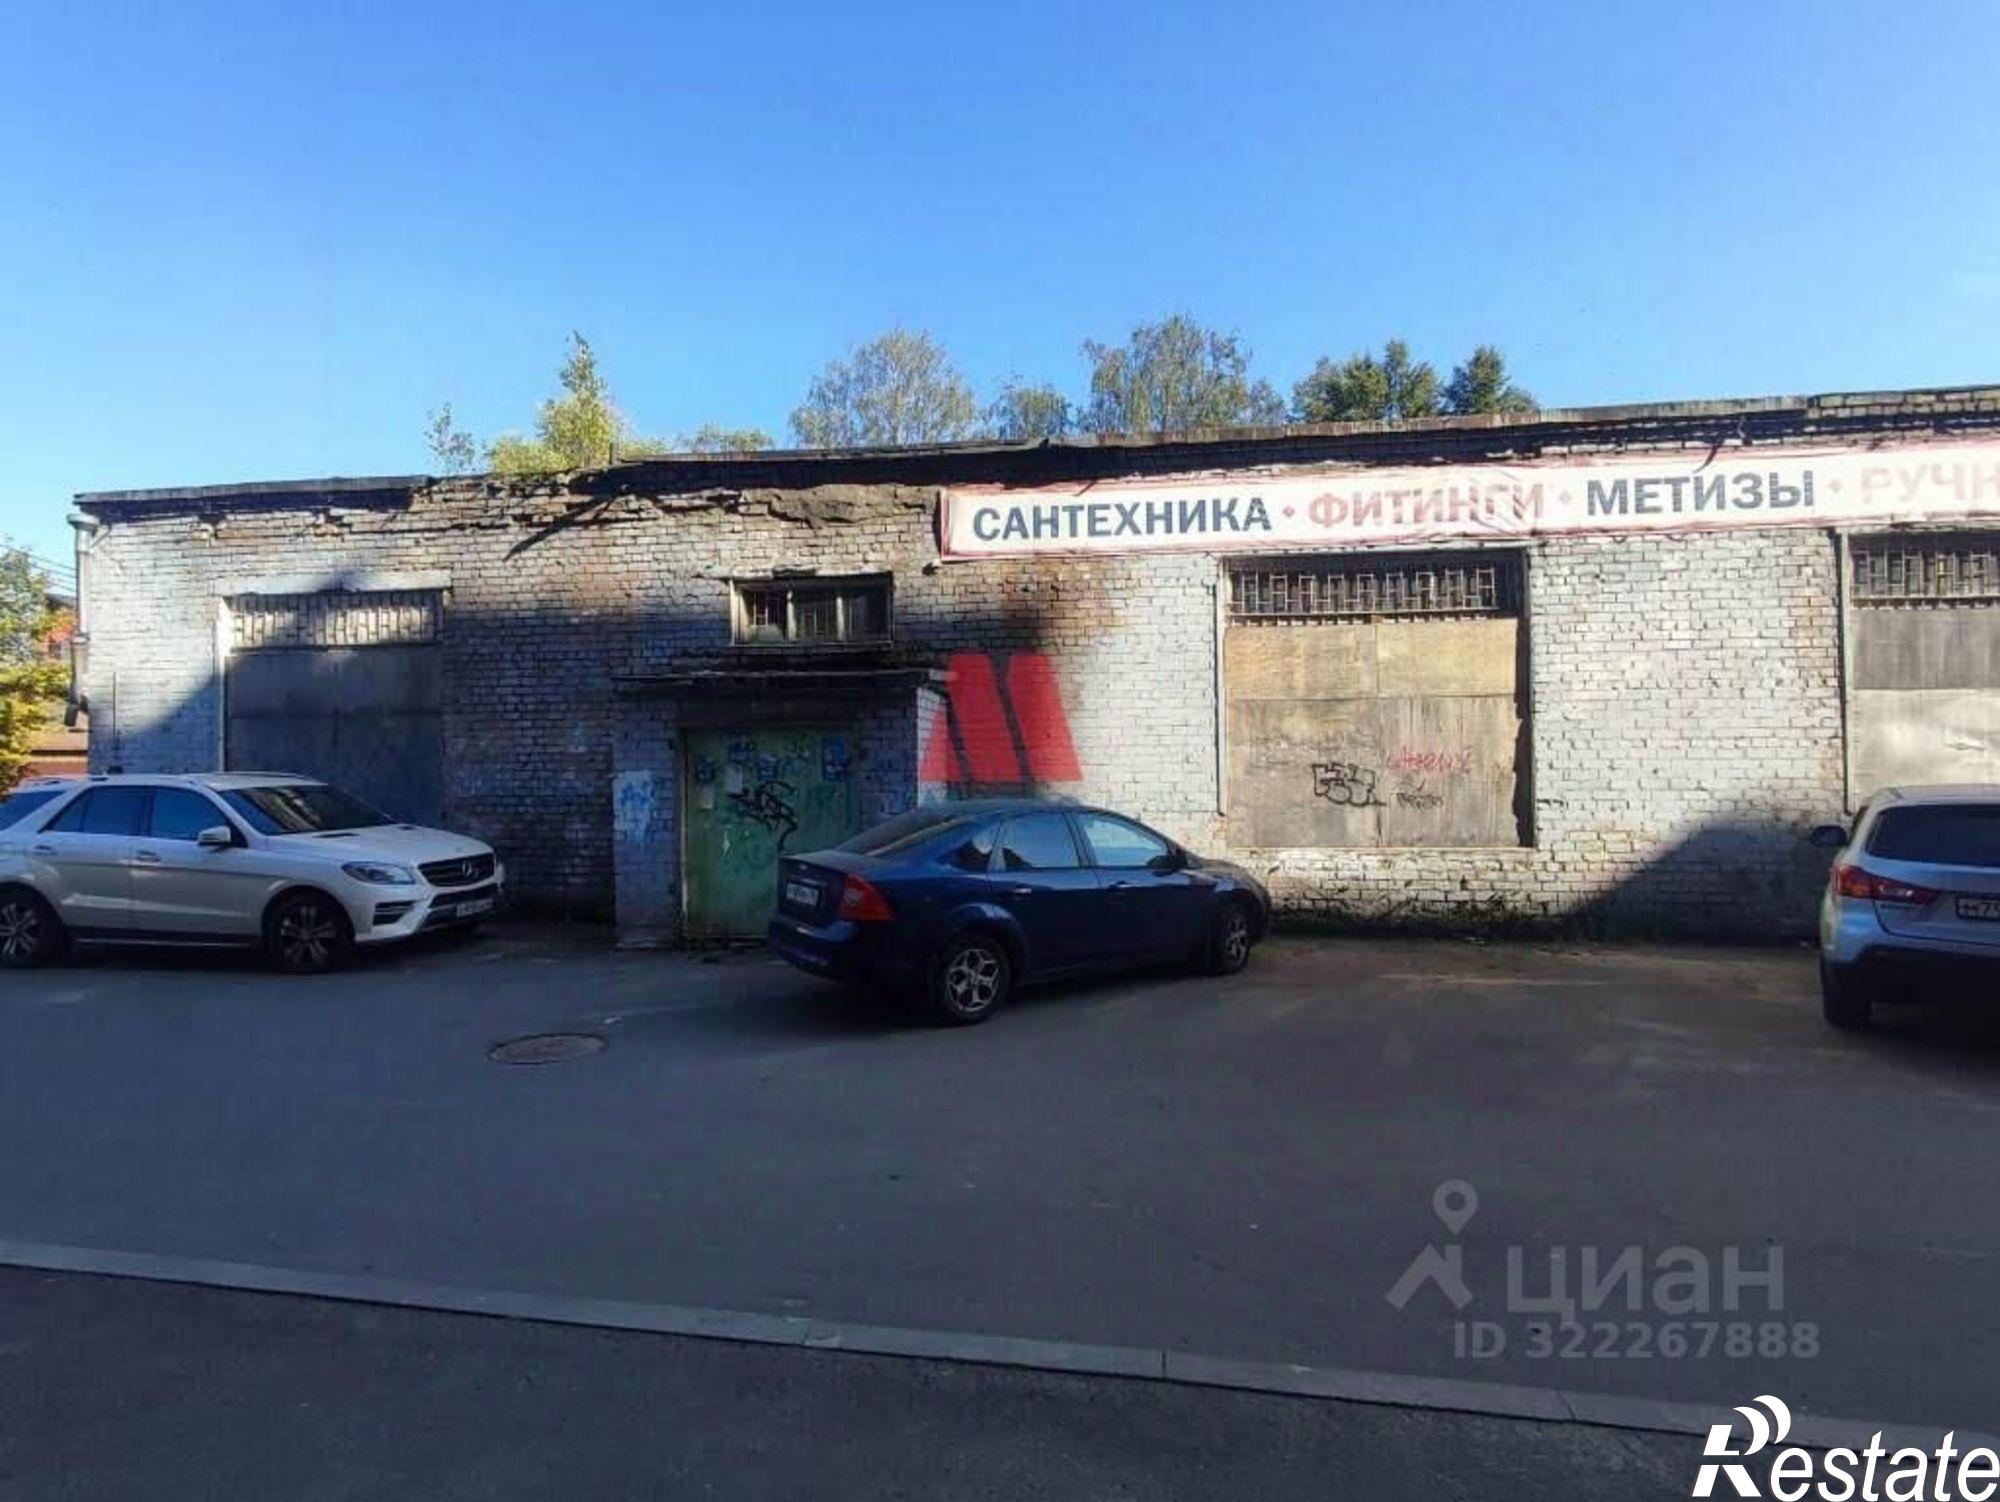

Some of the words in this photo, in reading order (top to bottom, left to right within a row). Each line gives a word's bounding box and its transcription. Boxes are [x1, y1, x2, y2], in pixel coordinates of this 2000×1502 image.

[973, 495, 1272, 542] САНТЕХНИКА
[1310, 483, 1543, 528] ФИТИНГИ
[1587, 470, 1815, 517] МЕТИЗЫ
